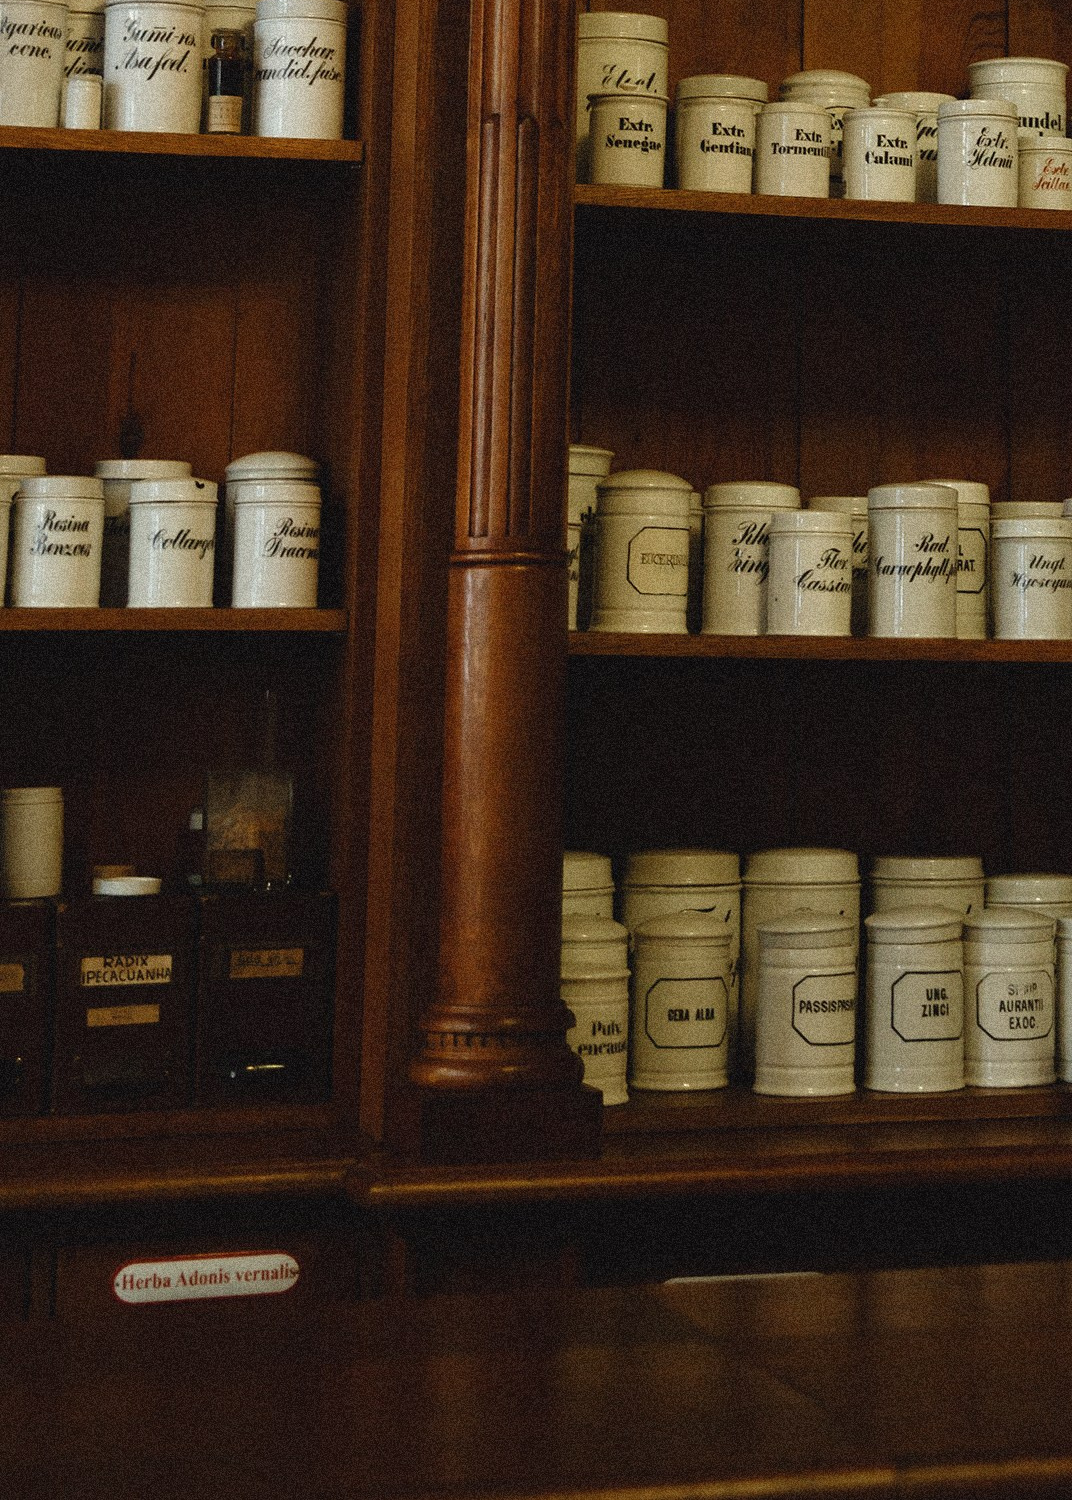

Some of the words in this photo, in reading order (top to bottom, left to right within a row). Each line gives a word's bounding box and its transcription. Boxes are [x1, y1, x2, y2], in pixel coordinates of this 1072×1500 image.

[618, 117, 654, 133] Extr.
[711, 122, 746, 138] Extr.
[876, 134, 908, 150] Extr.
[914, 533, 949, 553] Rad.
[121, 1273, 172, 1291] Herba
[177, 1267, 231, 1287] Adonis
